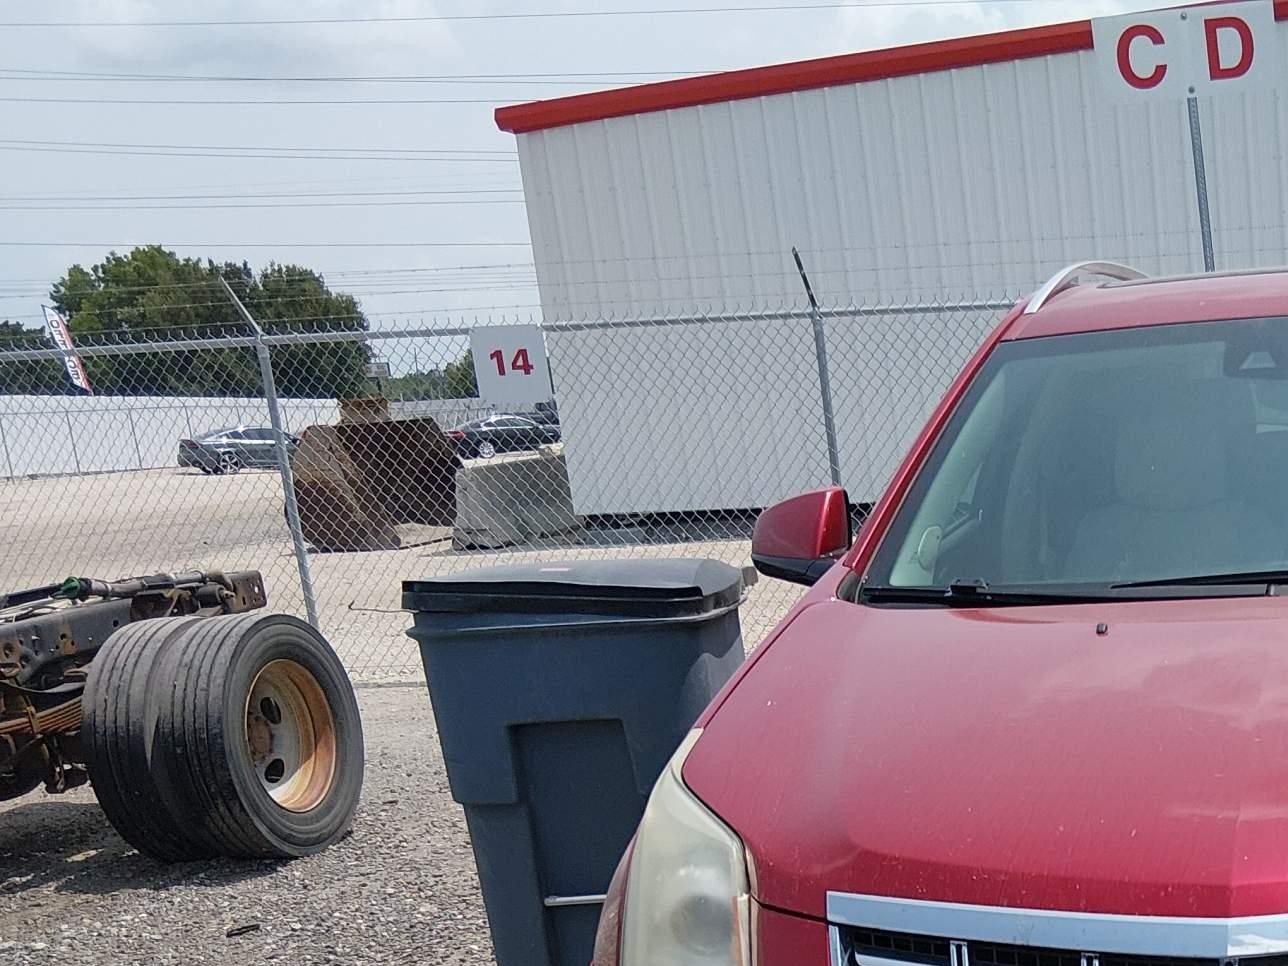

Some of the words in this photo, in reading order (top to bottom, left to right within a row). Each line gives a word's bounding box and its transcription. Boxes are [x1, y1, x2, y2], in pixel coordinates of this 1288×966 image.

[1116, 24, 1168, 90] C
[1204, 16, 1255, 80] D
[489, 348, 535, 376] 14
